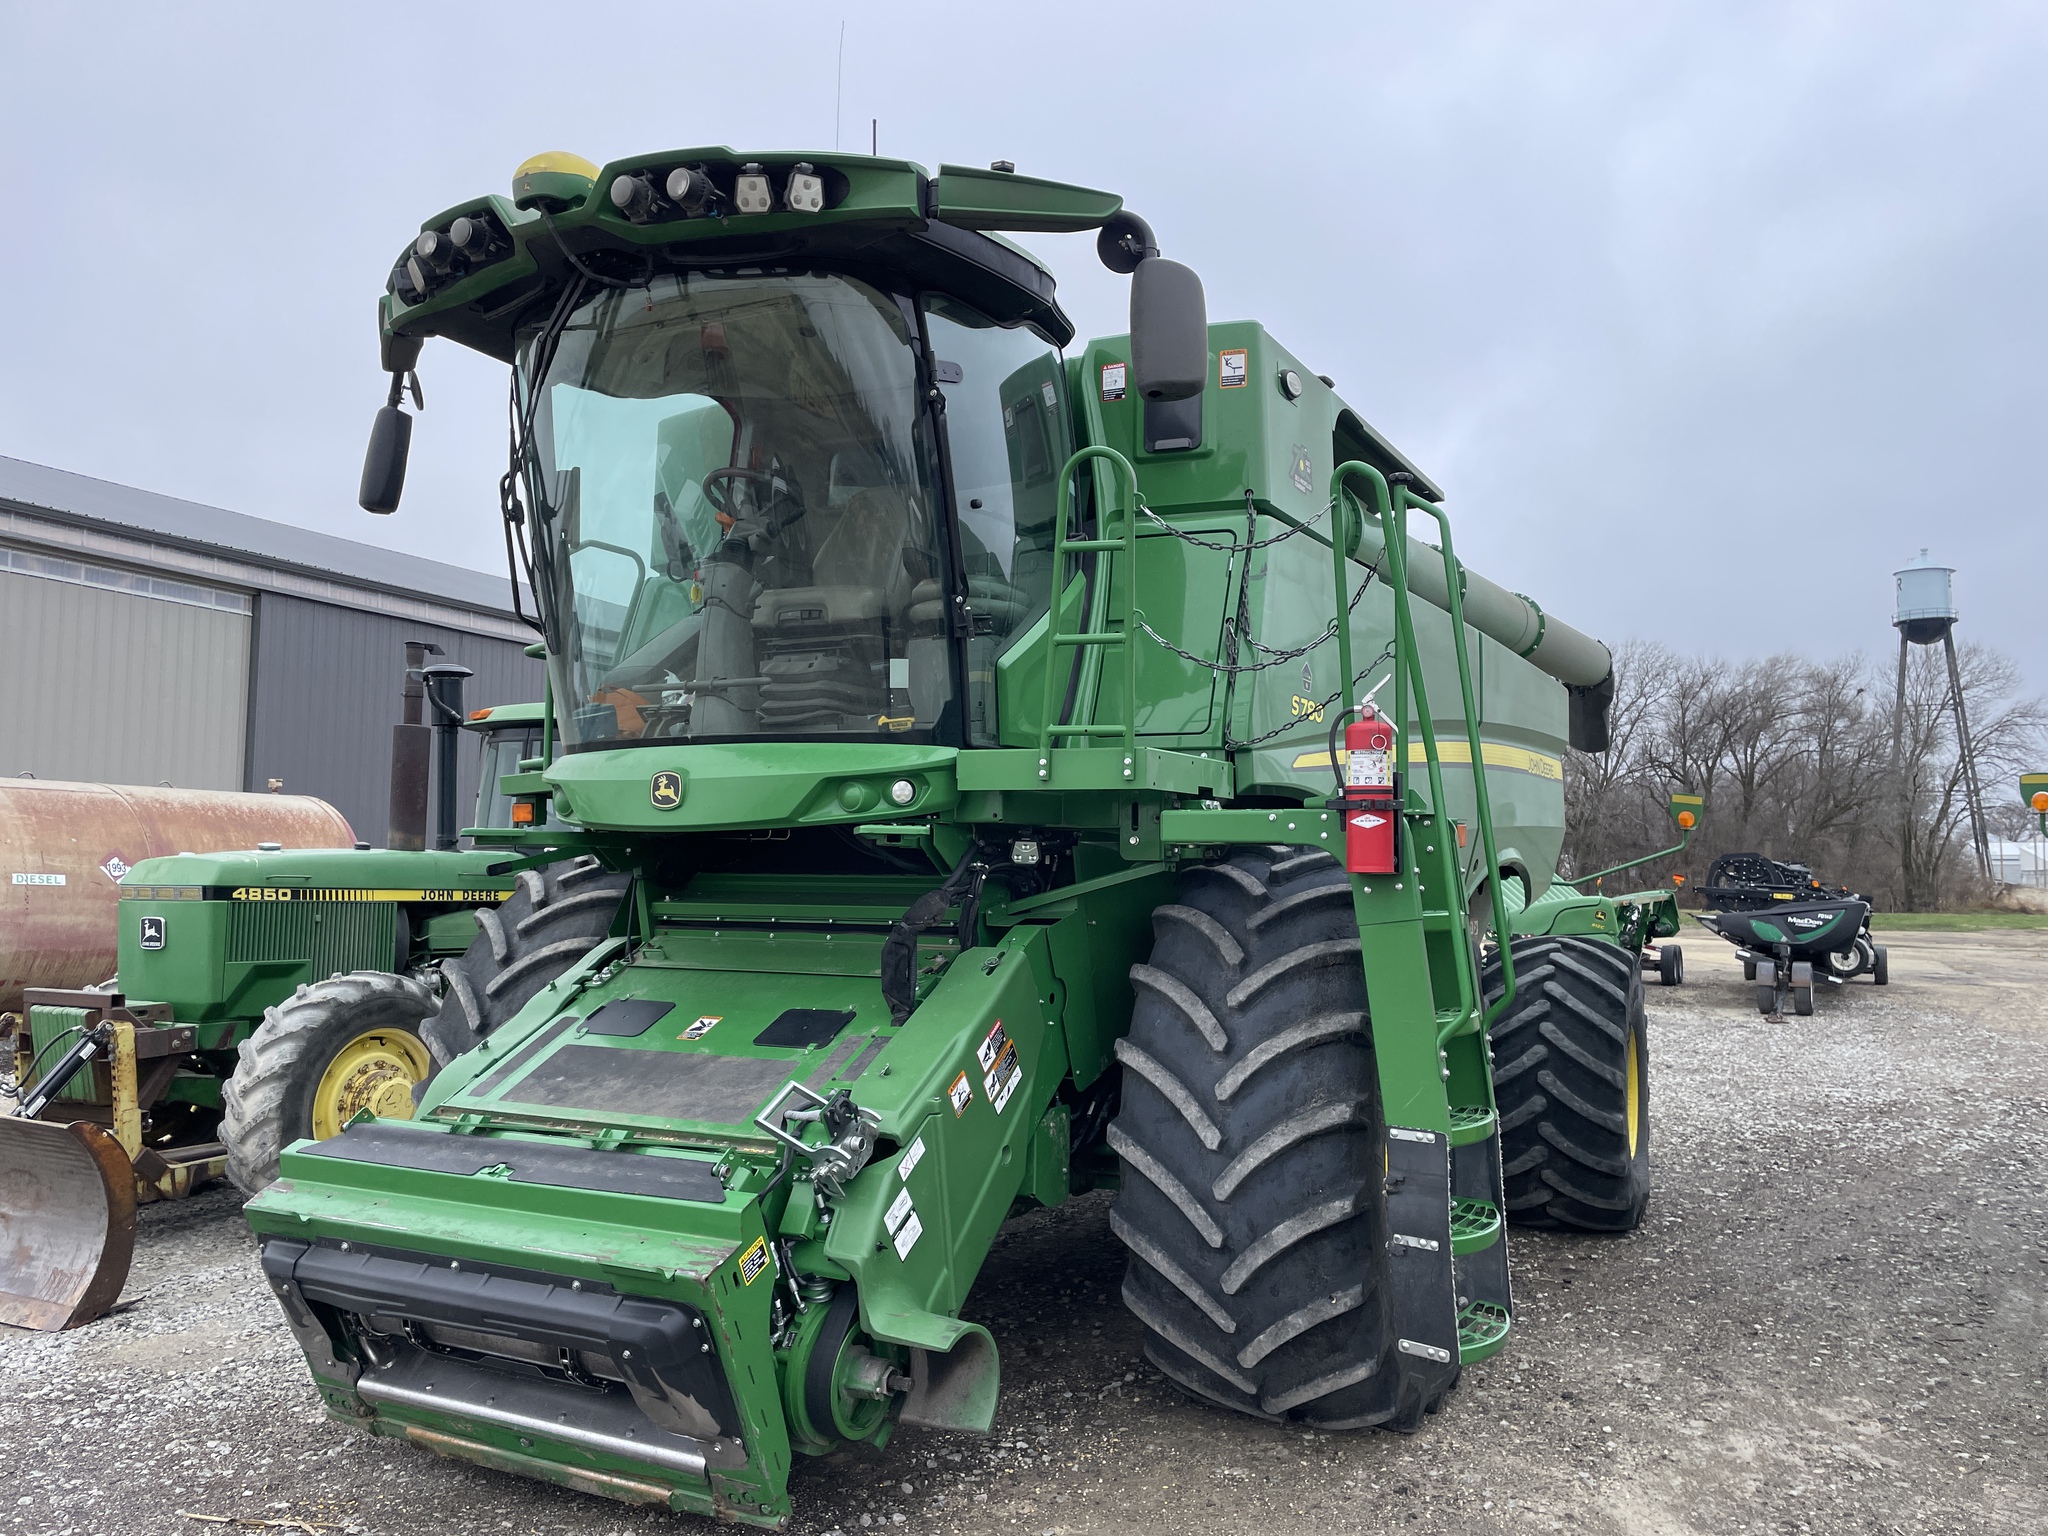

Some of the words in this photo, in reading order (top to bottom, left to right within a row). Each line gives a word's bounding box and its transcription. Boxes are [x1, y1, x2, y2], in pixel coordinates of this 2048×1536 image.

[1291, 695, 1324, 723] S780
[107, 863, 127, 873] 1993
[232, 888, 291, 901] 4850
[421, 890, 454, 901] JOHN
[462, 890, 499, 901] DEERE
[1787, 916, 1823, 925] MacDon
[743, 1237, 763, 1260] CAUTION
